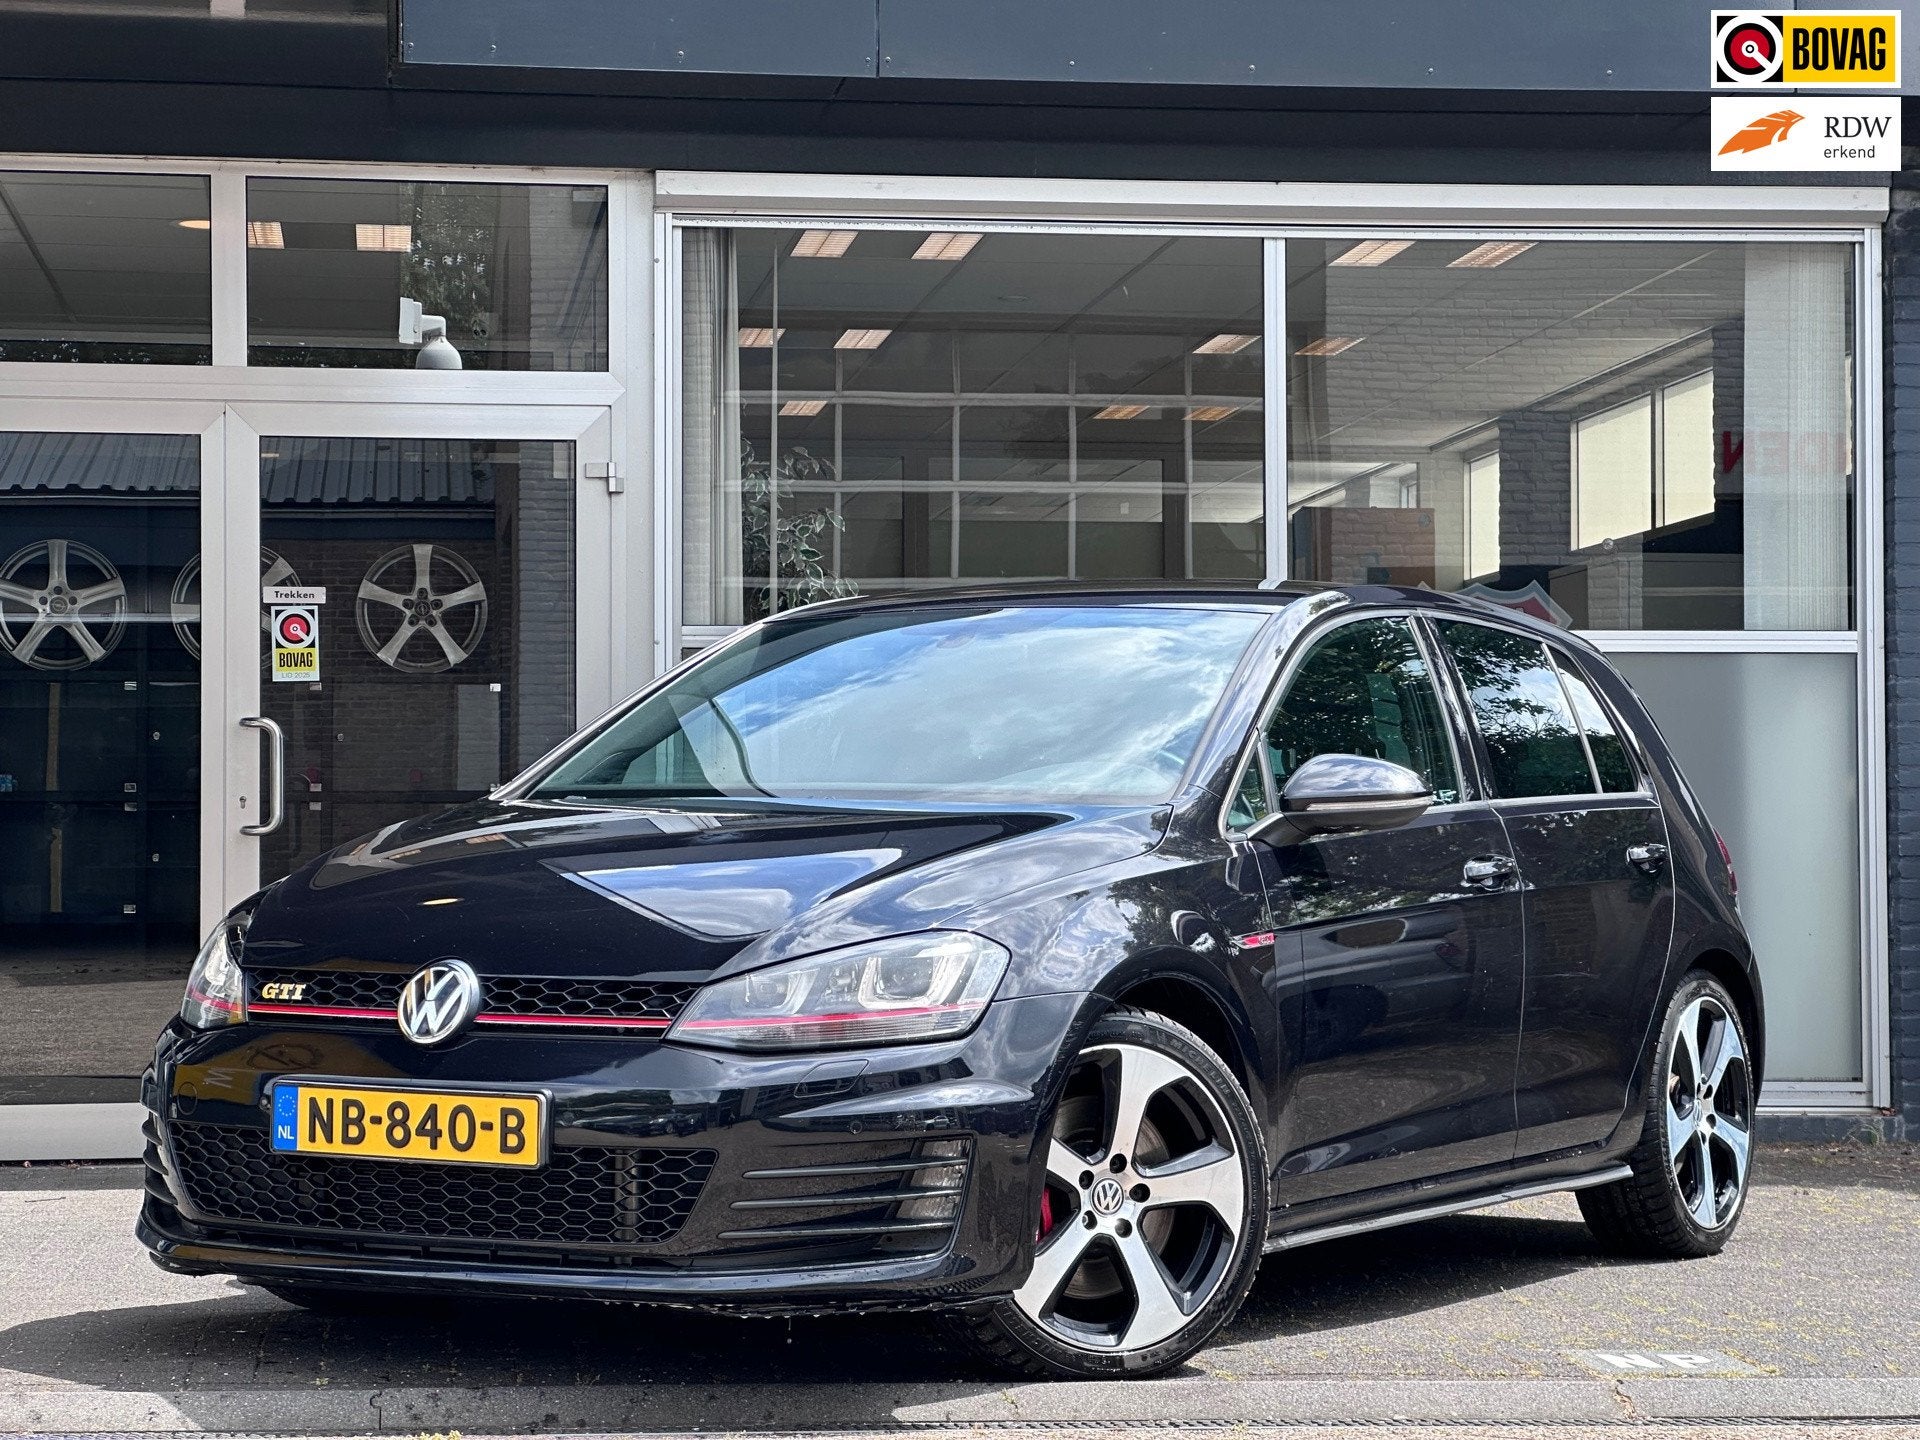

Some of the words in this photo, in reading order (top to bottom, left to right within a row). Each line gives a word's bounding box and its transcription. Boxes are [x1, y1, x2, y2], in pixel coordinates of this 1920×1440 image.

[274, 590, 315, 599] Trekken
[278, 652, 313, 668] BOVAG
[261, 982, 307, 1001] GTI
[277, 1125, 295, 1140] NL
[307, 1096, 526, 1155] NB-840-B
